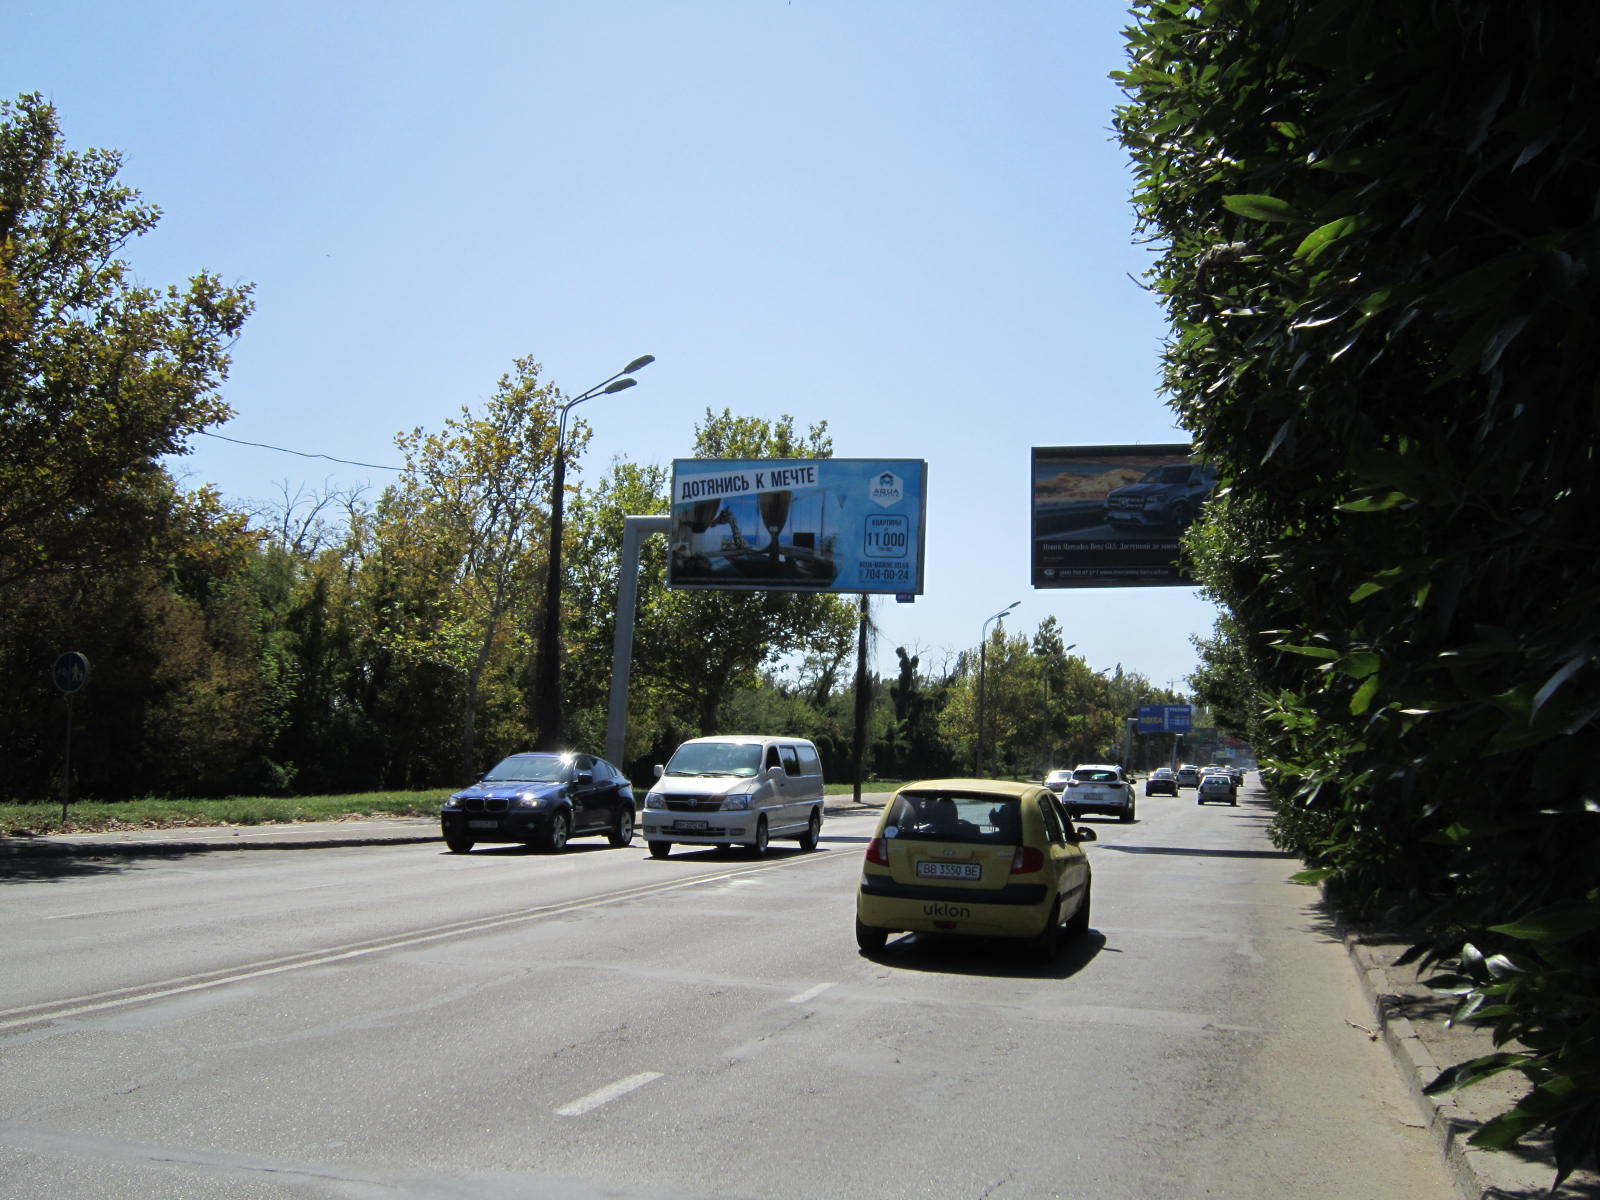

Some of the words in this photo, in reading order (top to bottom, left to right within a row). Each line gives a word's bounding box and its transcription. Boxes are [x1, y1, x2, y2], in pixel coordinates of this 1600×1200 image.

[682, 474, 750, 499] ДОТЯНИСЬ
[756, 473, 764, 488] К
[771, 466, 816, 487] МЕЧТЕ
[923, 903, 970, 918] uklon
